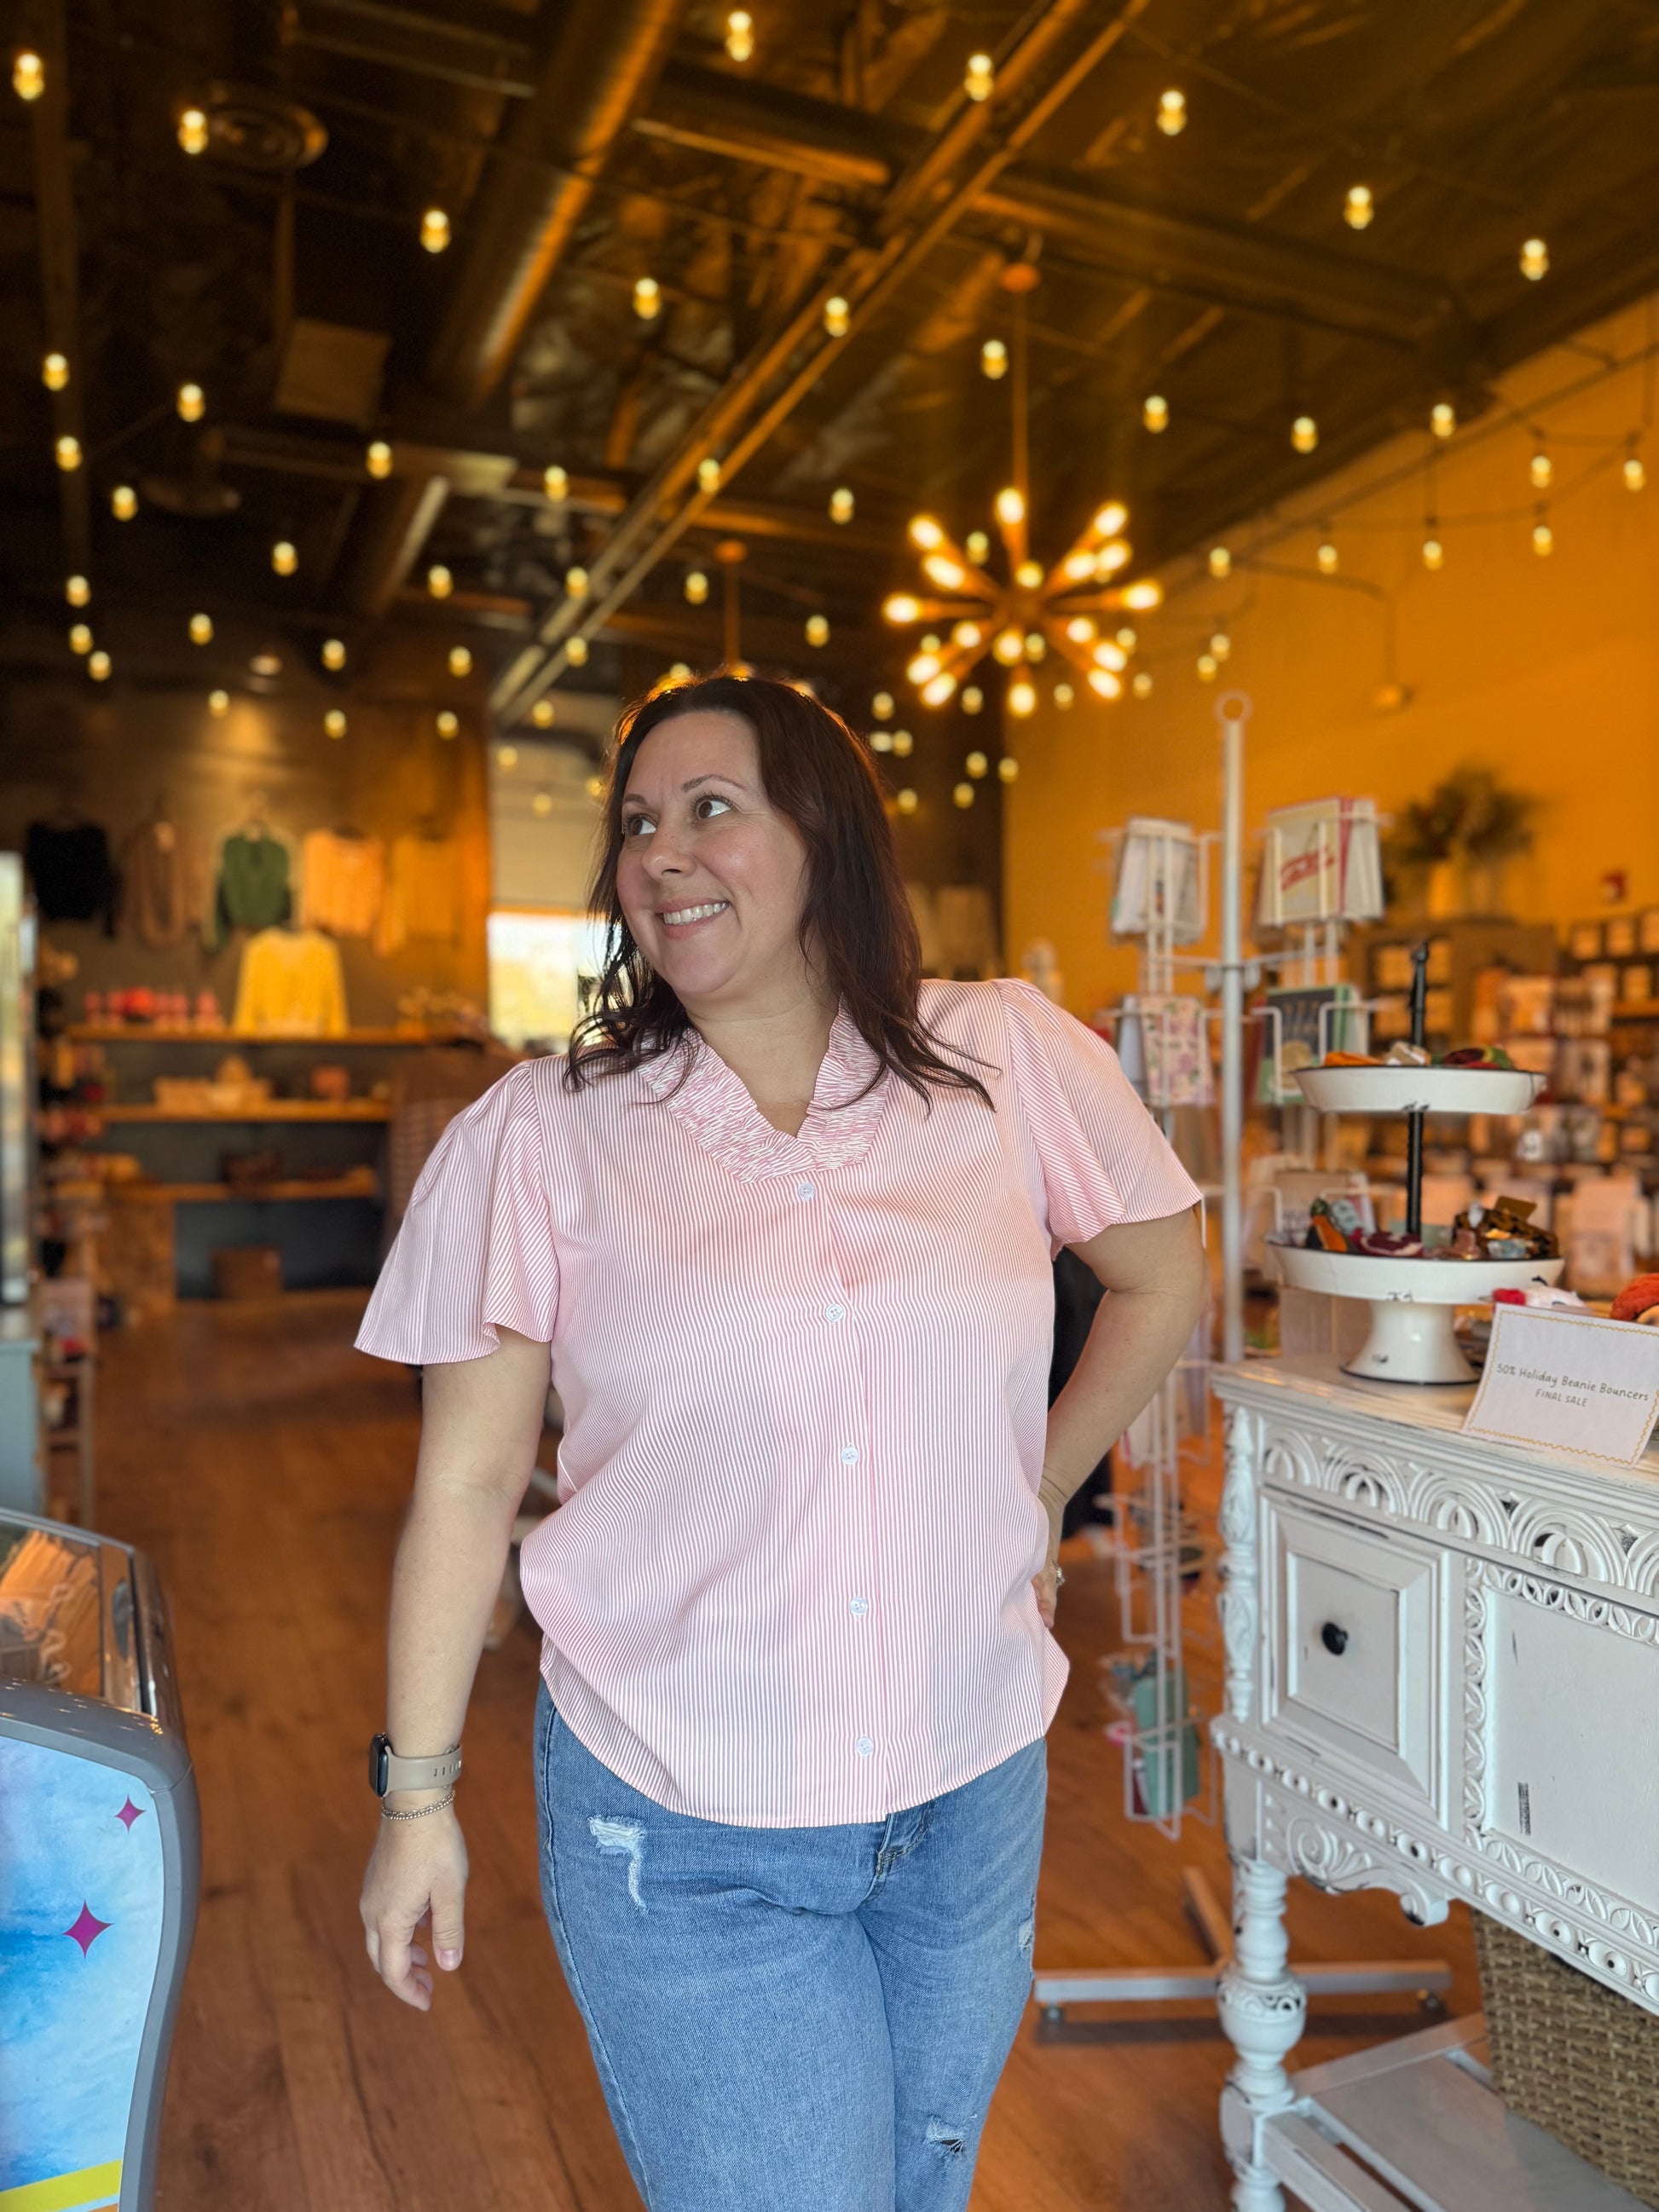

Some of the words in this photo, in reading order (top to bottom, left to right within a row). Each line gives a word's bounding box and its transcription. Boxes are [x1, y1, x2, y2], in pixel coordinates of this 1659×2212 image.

[1496, 1364, 1516, 1376] 50%
[1519, 1368, 1558, 1388] Holiday
[1561, 1376, 1596, 1391] Beanie
[1599, 1383, 1649, 1401] Bouncers
[1535, 1389, 1562, 1402] FINAL
[1565, 1395, 1588, 1407] SALE
